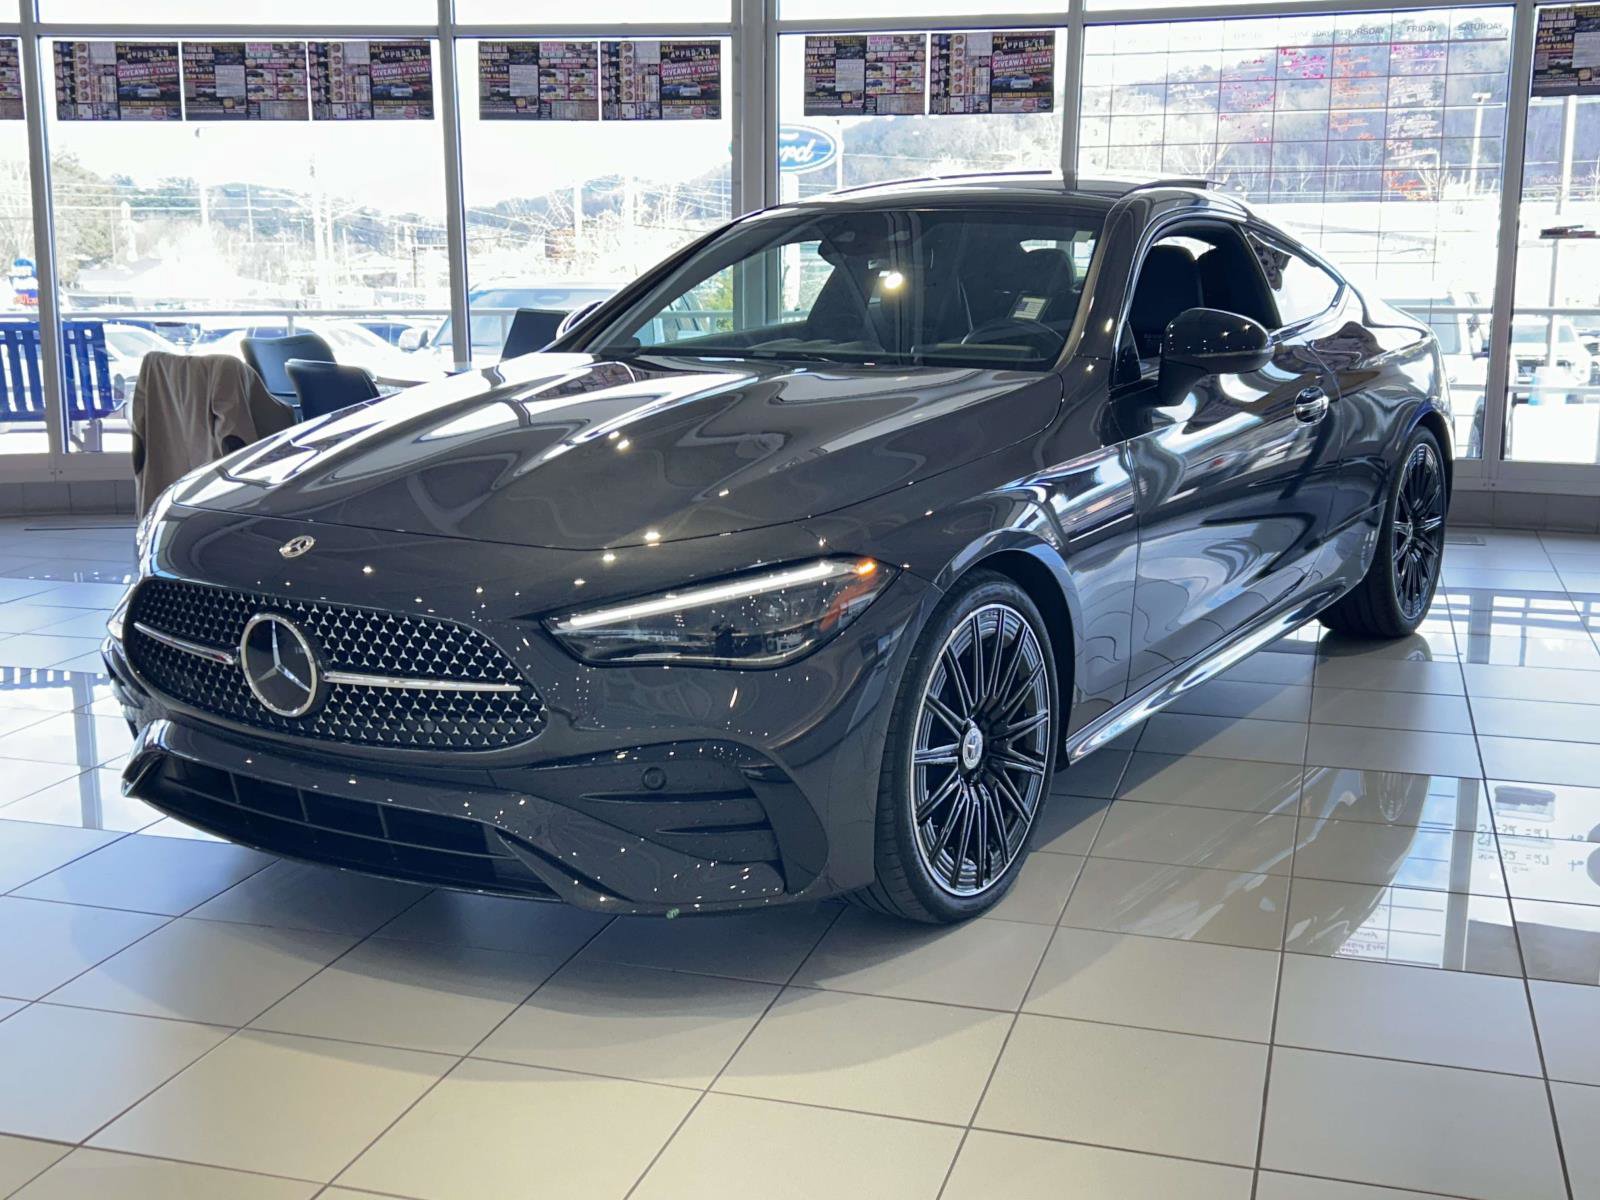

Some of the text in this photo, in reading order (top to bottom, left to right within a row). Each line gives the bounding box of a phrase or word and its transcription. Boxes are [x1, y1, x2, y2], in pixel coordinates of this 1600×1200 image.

[1406, 25, 1437, 33] FRIDAY
[1457, 23, 1502, 31] SATURDAY
[993, 58, 1028, 68] GIVEAWAY
[372, 67, 406, 76] GIVEAWAY
[661, 66, 696, 77] GIVEAWAY
